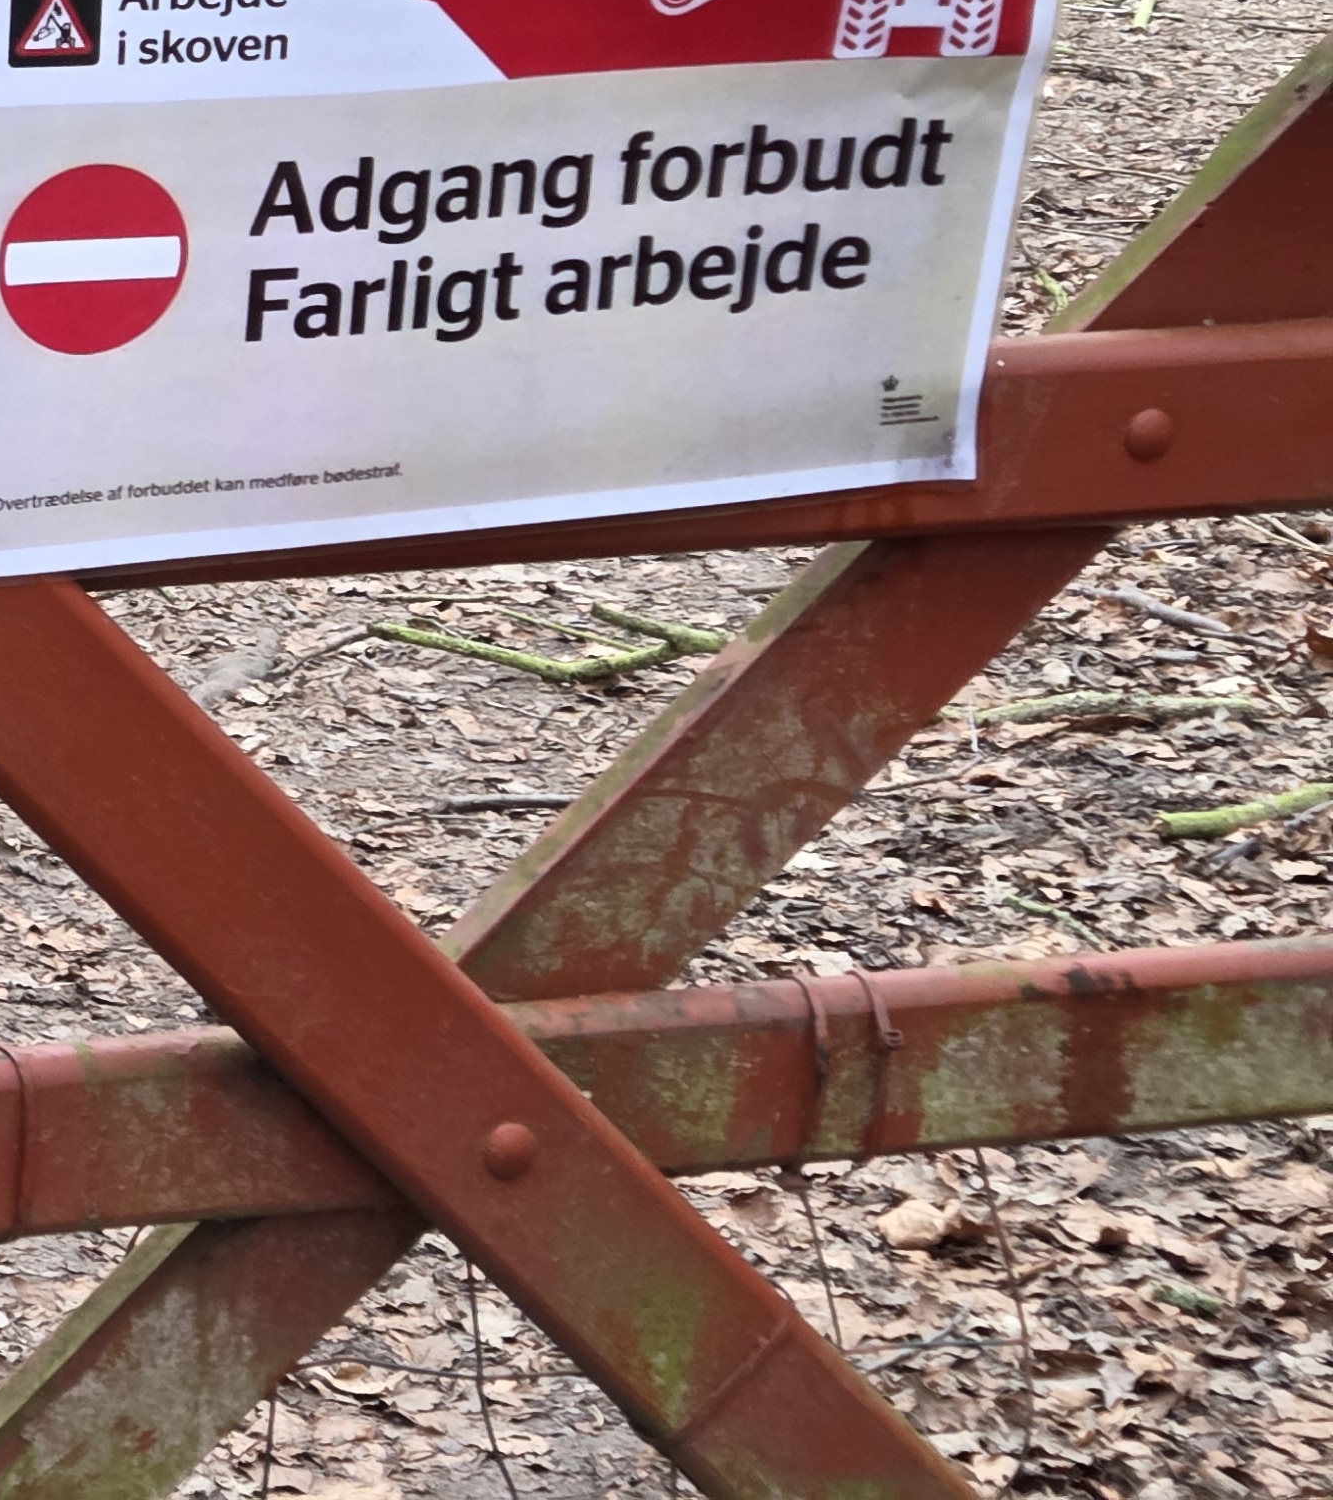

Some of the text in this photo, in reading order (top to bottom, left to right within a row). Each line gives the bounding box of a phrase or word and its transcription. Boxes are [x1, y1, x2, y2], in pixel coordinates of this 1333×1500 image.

[117, 29, 289, 65] i skoven
[249, 118, 955, 245] Adgang forbudt
[244, 223, 872, 342] Farligt arbejde
[107, 485, 124, 501] af
[126, 478, 210, 498] forbuddet
[214, 477, 245, 493] kan
[248, 470, 319, 489] medføre
